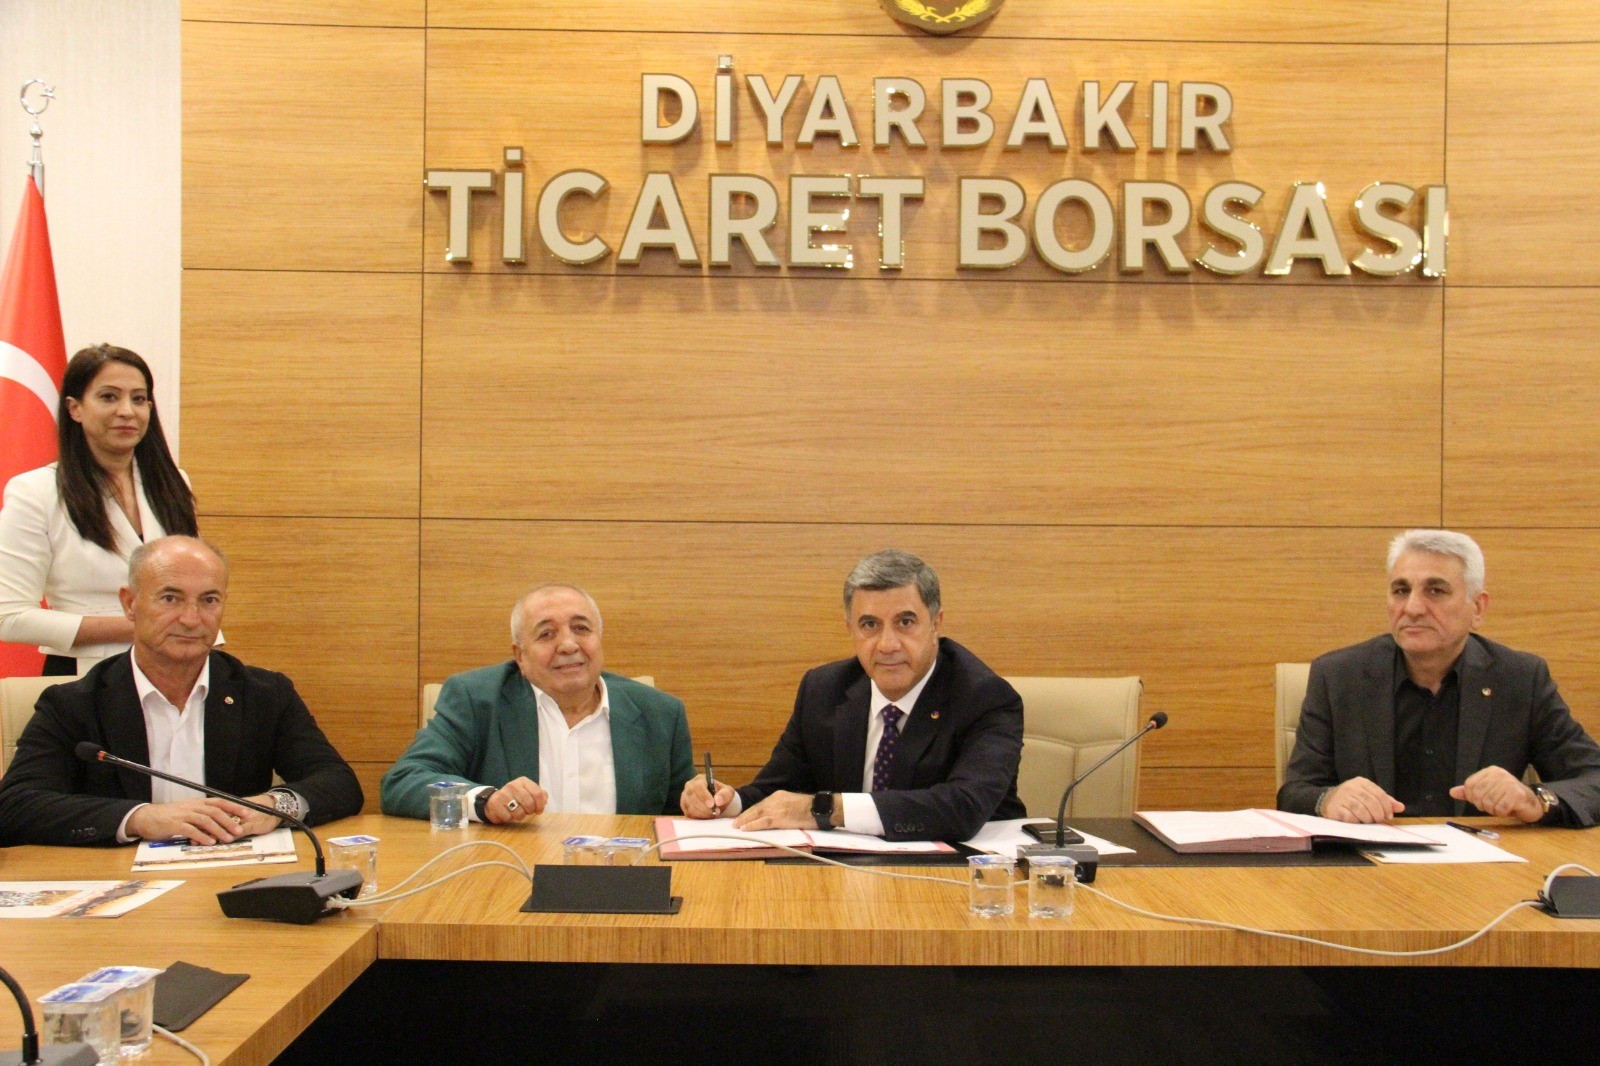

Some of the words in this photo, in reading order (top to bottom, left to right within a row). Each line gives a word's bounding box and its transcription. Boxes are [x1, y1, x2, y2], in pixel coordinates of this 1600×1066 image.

[640, 54, 1233, 153] DİYARBAKIR
[424, 146, 926, 270] TİCARET
[957, 176, 1448, 278] BORSASI
